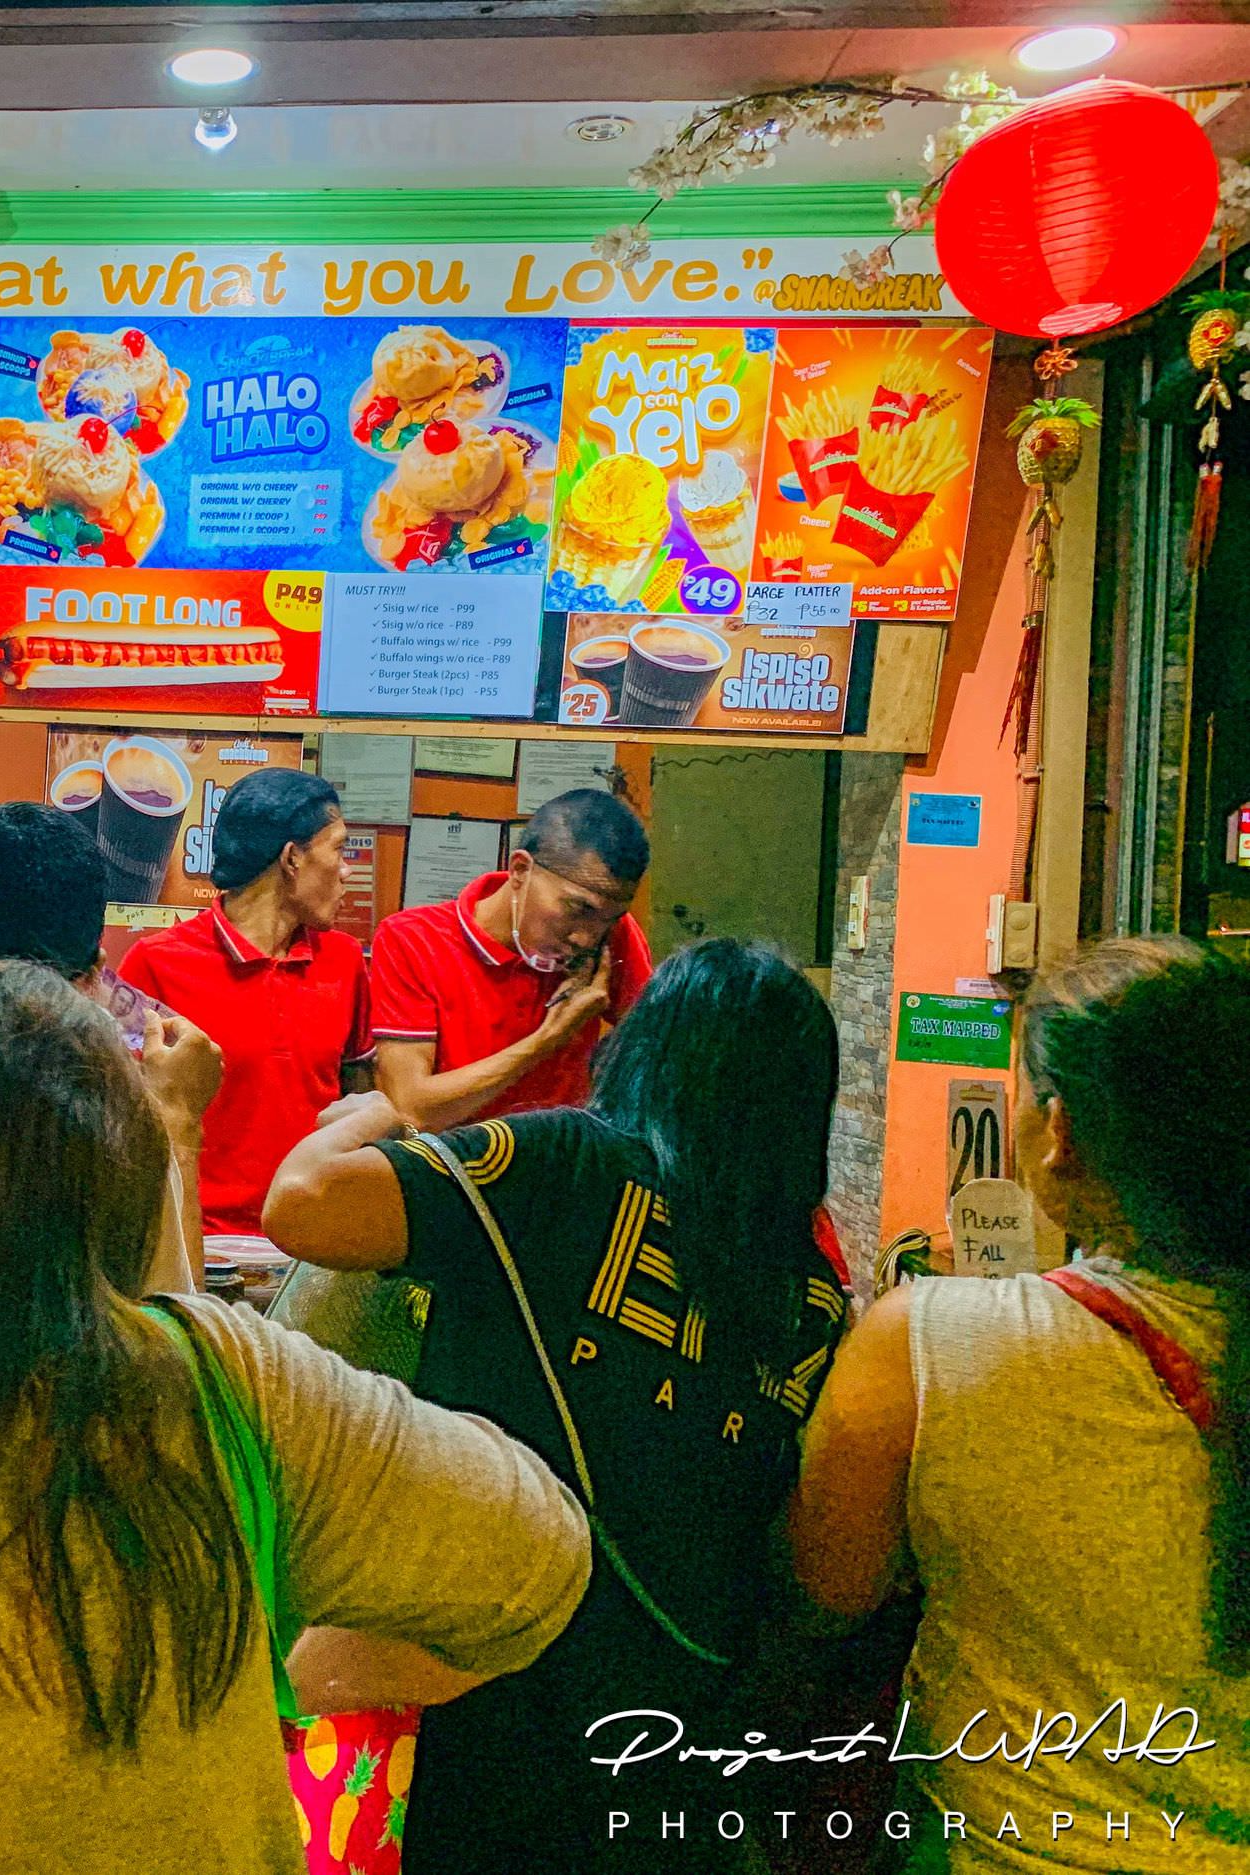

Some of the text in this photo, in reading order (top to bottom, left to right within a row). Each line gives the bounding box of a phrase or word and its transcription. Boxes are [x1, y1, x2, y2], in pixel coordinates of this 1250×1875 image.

[99, 251, 287, 314] what
[322, 259, 471, 316] you
[597, 351, 722, 398] Maiz
[207, 376, 318, 420] HALO
[645, 393, 678, 408] con
[589, 384, 740, 467] Yelo
[216, 413, 326, 455] HALO
[263, 483, 298, 491] CHERRY
[200, 497, 239, 505] ORIGINAL
[276, 583, 323, 604] P49
[345, 585, 406, 596] MUST TRY!!!
[747, 586, 840, 599] LARGE PLATTER
[860, 586, 945, 595] Add-on Flavors
[25, 586, 241, 627] FOOT LONG
[382, 603, 404, 614] Sisig
[407, 604, 419, 613] w/
[421, 604, 439, 613] rice
[381, 620, 403, 631] Sisig
[405, 621, 424, 630] w/o
[427, 621, 443, 630] rice
[380, 637, 414, 646] Buffalo
[417, 637, 445, 648] wings
[448, 638, 460, 647] w/
[462, 638, 479, 647] rice
[379, 653, 413, 663] Buffalo
[415, 654, 444, 664] wings
[446, 655, 465, 664] w/o
[468, 655, 484, 663] rice
[744, 648, 829, 685] Ispiso
[378, 669, 410, 680] Burger
[413, 670, 439, 679] Steak
[441, 670, 470, 681] (2pcs)
[377, 686, 409, 697] Burger
[412, 686, 437, 695] Steak
[440, 686, 464, 697] (1pc)
[723, 678, 839, 712] Sikwate
[732, 717, 759, 726] NOW
[911, 1017, 1000, 1039] TAX MAPPED
[962, 1208, 1020, 1230] PLEASE
[964, 1236, 1005, 1263] FALL
